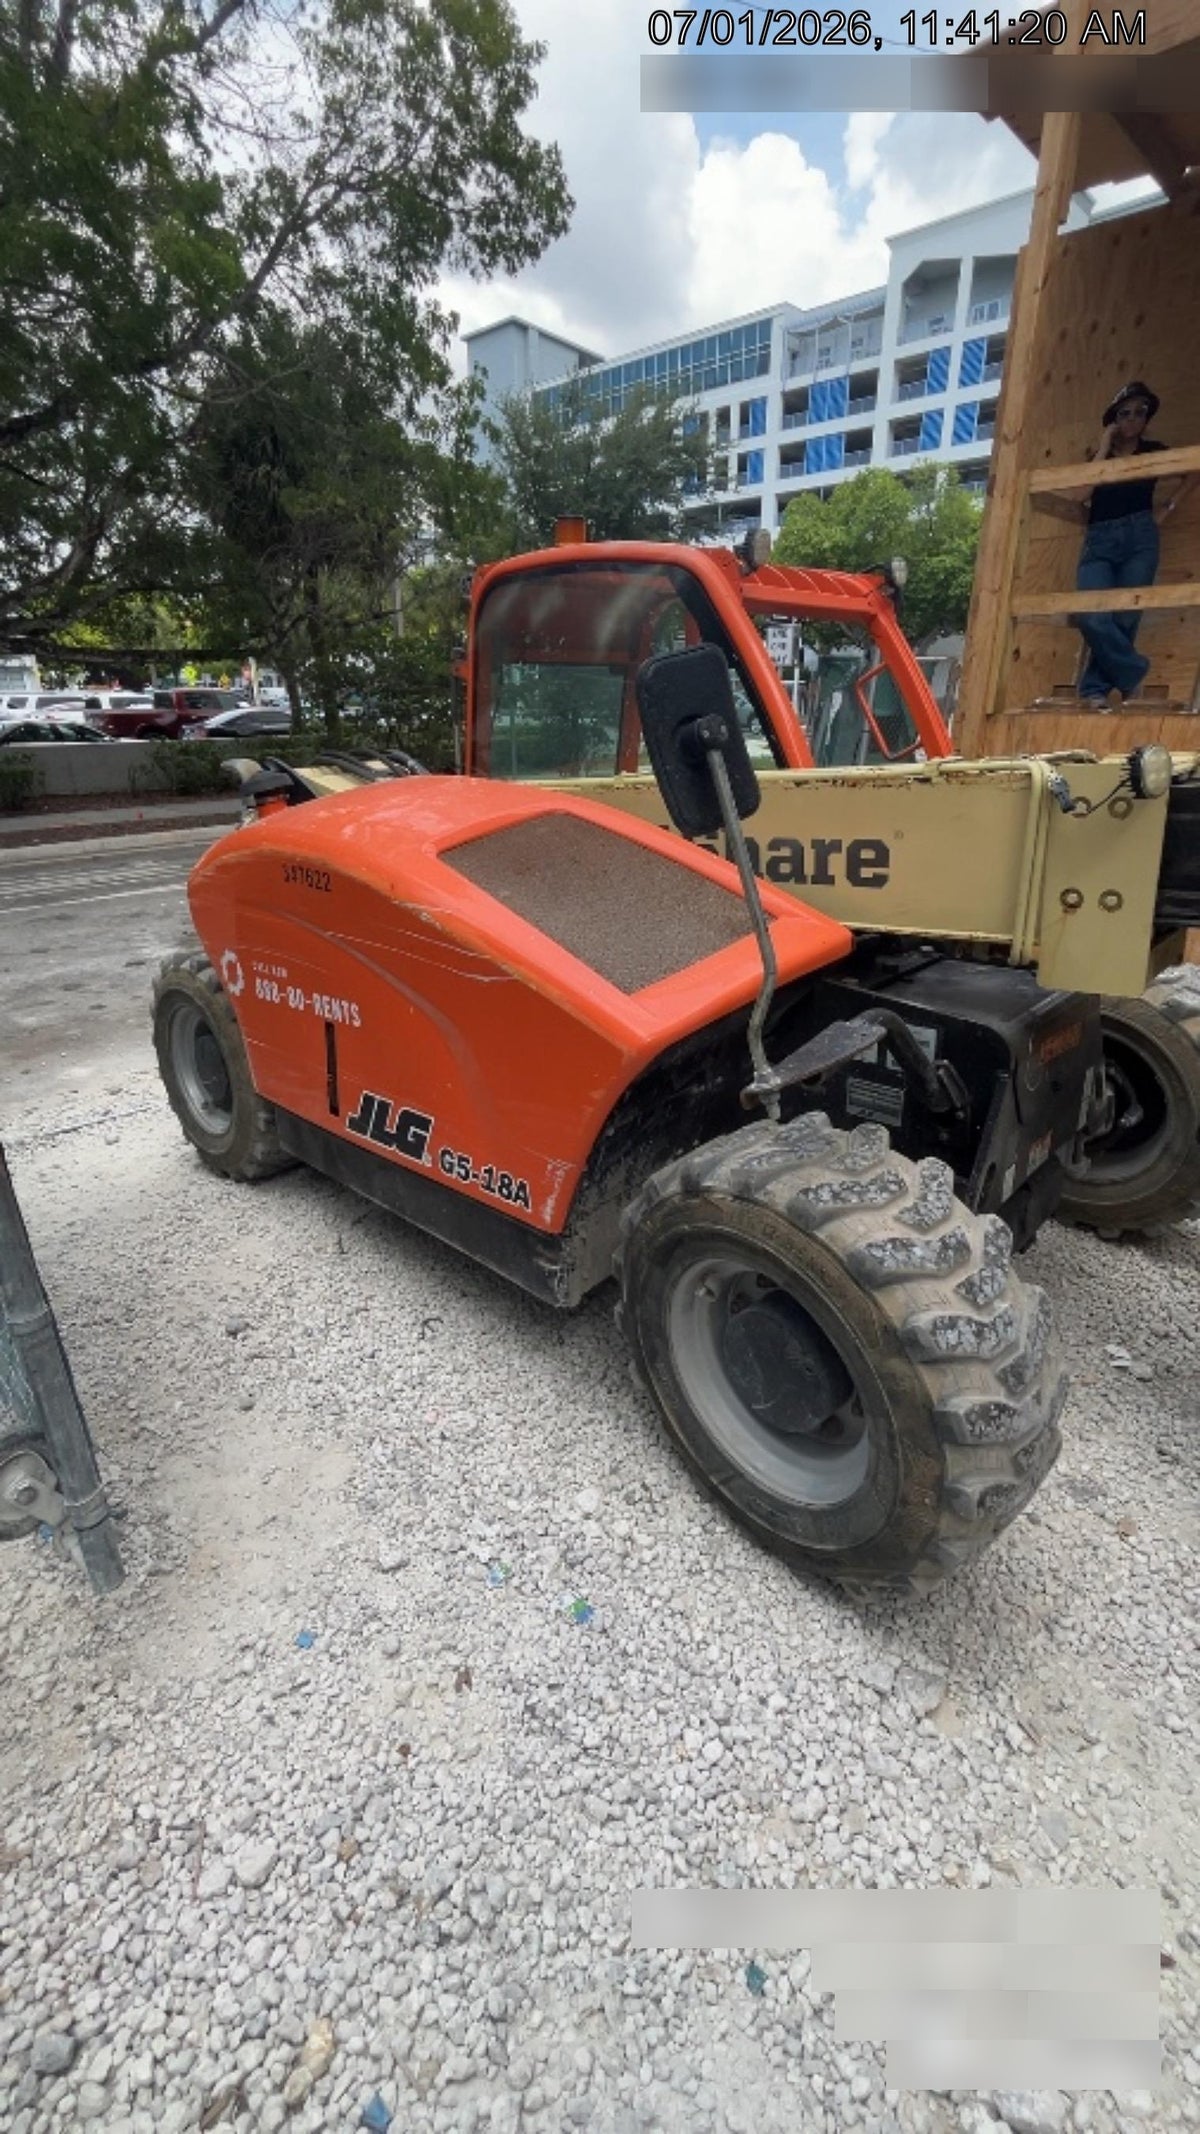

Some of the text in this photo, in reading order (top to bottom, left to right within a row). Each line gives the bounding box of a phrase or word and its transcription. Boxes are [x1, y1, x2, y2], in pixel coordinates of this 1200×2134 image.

[697, 832, 891, 888] hare
[346, 1090, 532, 1212] JLG G5-18A
